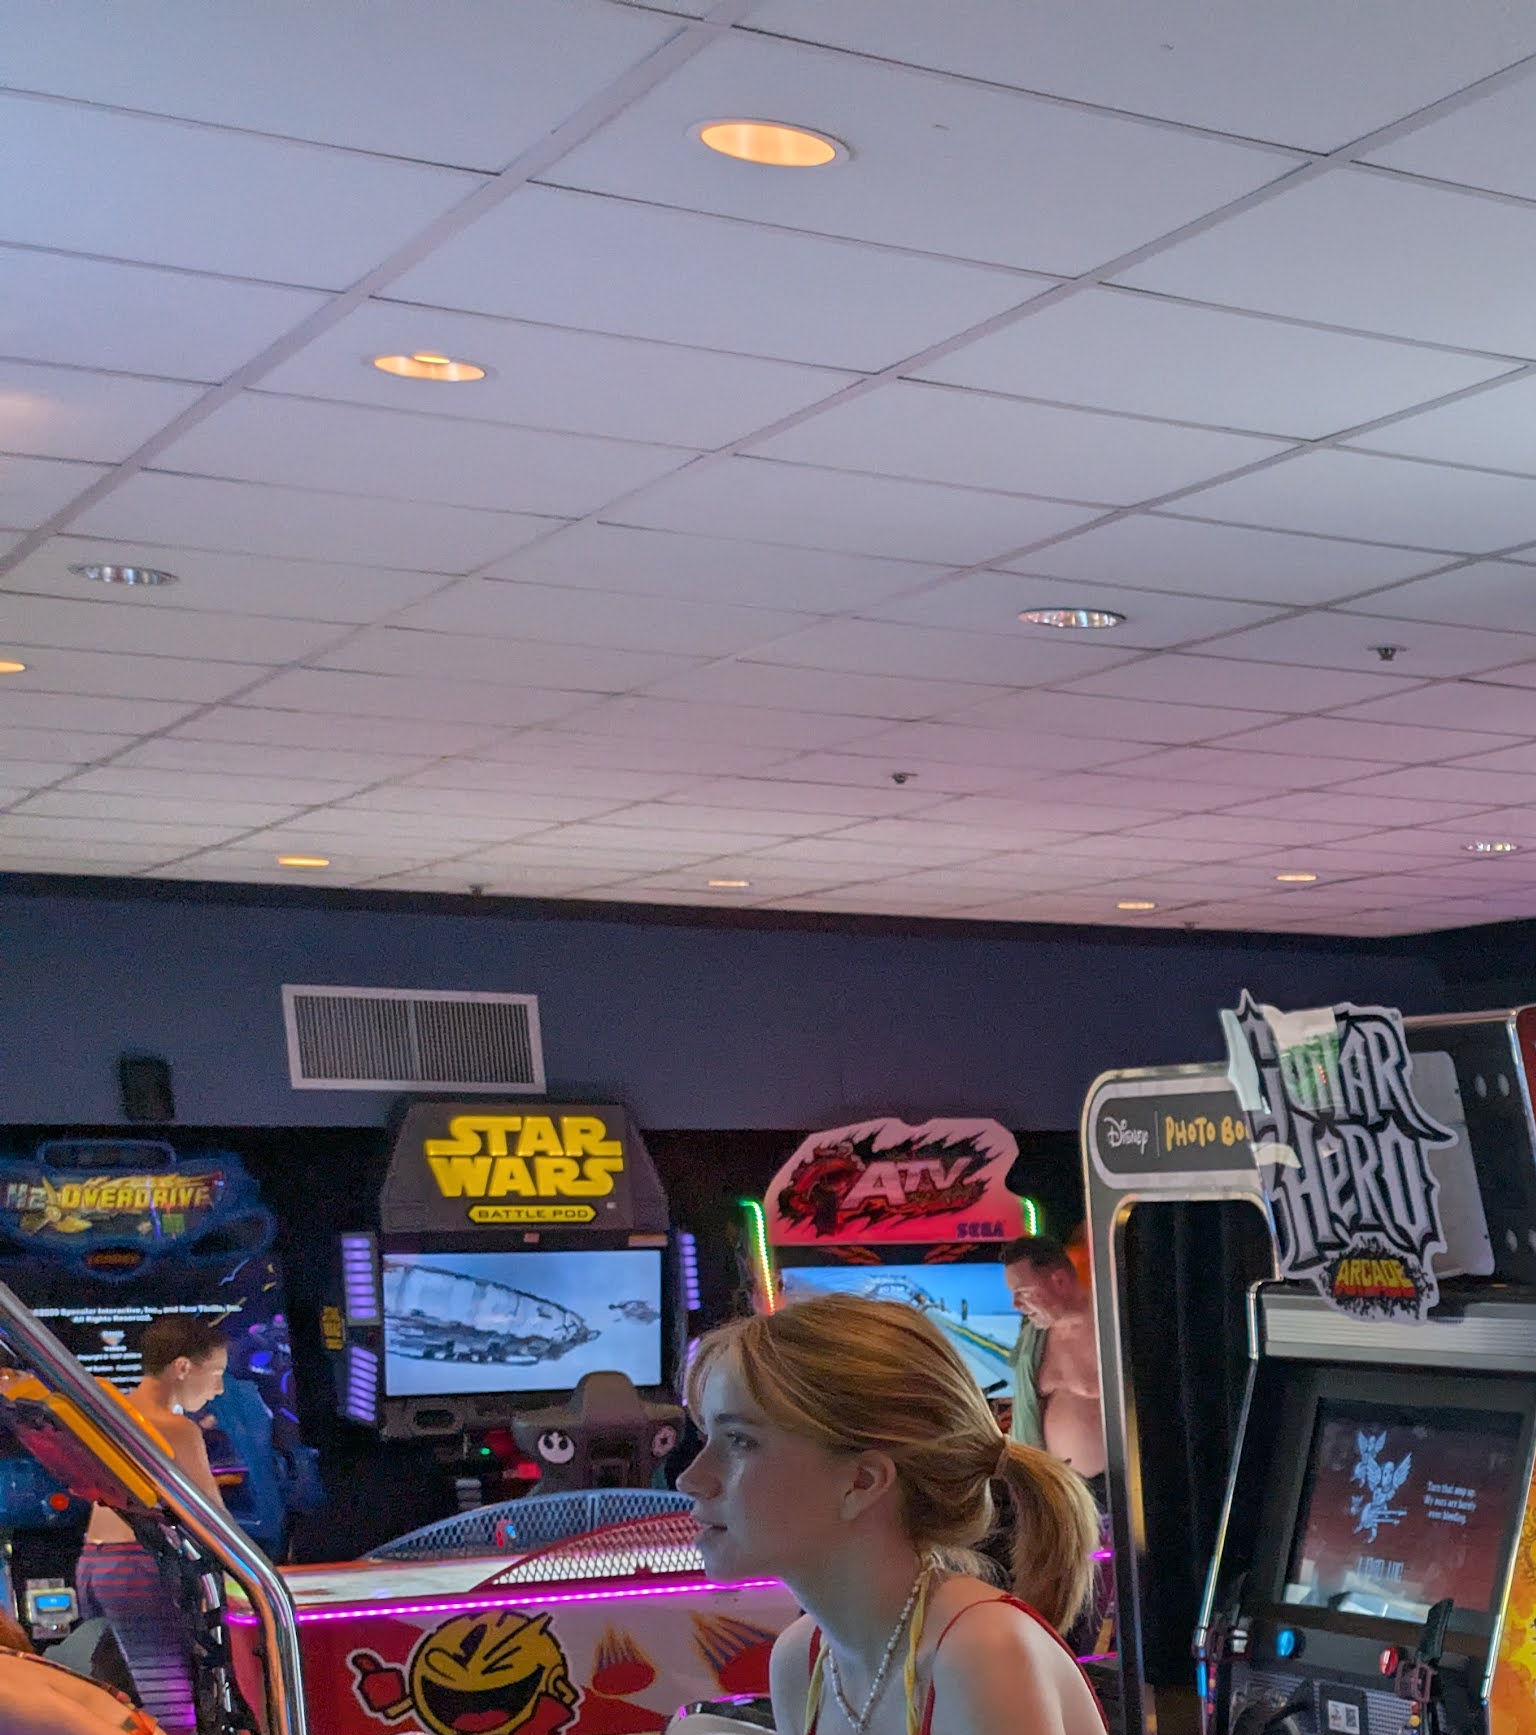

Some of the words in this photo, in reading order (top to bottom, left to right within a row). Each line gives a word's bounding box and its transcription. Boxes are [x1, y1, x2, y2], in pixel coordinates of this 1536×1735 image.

[424, 1116, 622, 1157] STAR
[1165, 1115, 1216, 1151] PHOTO
[1221, 1116, 1250, 1146] BO
[427, 1157, 623, 1197] WARS
[840, 1157, 972, 1209] ATV
[478, 1209, 545, 1219] BATTLE
[552, 1209, 589, 1219] POD
[957, 1222, 1004, 1237] SEGA
[1336, 1259, 1415, 1291] ARCADE
